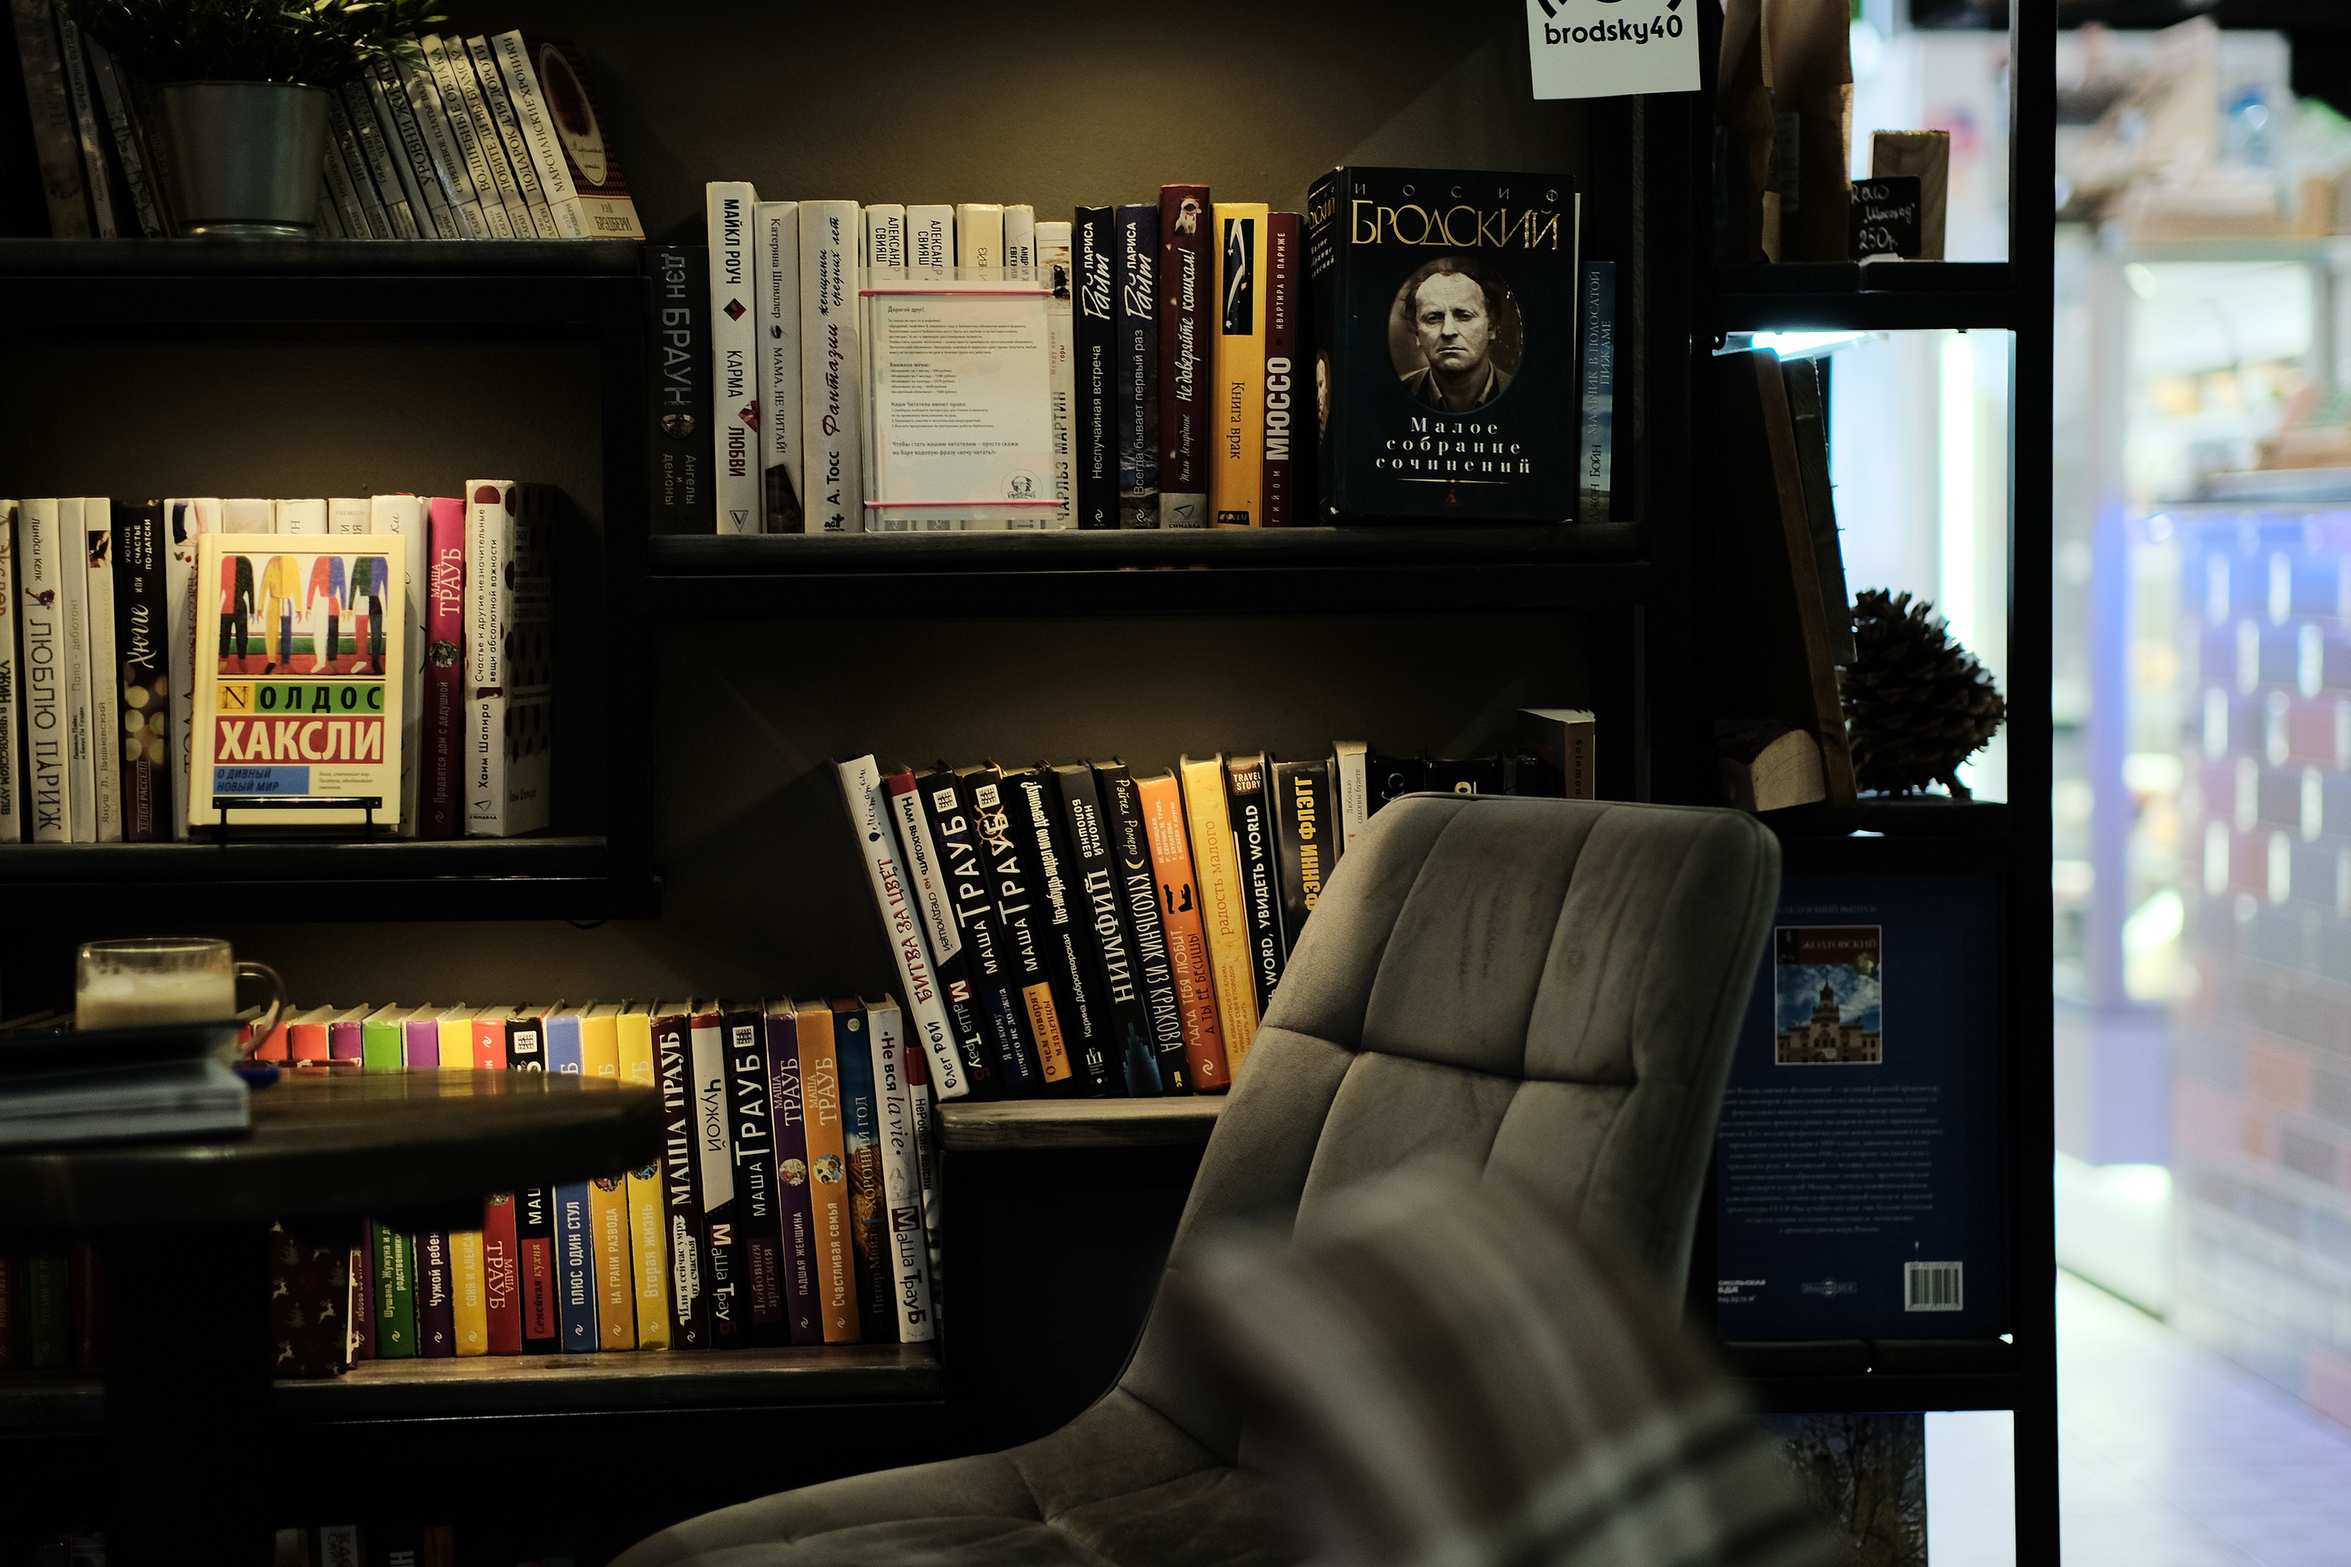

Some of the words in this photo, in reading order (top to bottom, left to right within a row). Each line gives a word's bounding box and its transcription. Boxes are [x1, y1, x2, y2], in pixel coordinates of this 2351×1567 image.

[1544, 14, 1683, 45] brodsky40
[472, 43, 502, 99] ДОРОТИ
[502, 36, 531, 97] ХРОНИКИ
[492, 100, 513, 129] ДЛЯ
[399, 119, 434, 186] УРОВНИ
[504, 129, 537, 192] ПОДАРОК
[524, 97, 565, 192] МАРСИАНСКИЕ
[1353, 183, 1559, 203] ИОСИФ
[723, 199, 739, 246] МАЙКЛ
[770, 218, 781, 268] Катерина
[829, 216, 840, 245] лет
[876, 227, 887, 262] СВИЯШ
[1083, 222, 1094, 269] ЛАРИСА
[1126, 222, 1137, 269] ЛАРИСА
[1351, 199, 1561, 251] БРОДСКИЙ
[726, 251, 741, 284] РОУЧ
[918, 231, 929, 265] СВИЯШ
[1277, 232, 1286, 269] ПАРИЖЕ
[771, 270, 784, 318] Шпиллер
[818, 249, 830, 316] женщины
[830, 254, 842, 307] средних
[1082, 252, 1111, 320] Райт
[1124, 252, 1153, 320] Райт
[1276, 284, 1285, 329] КВАРТИРА
[1134, 329, 1145, 351] раз
[1601, 320, 1612, 384] ПИЖАМЕ
[728, 350, 743, 398] КАРМА
[822, 323, 841, 436] Фантазии
[1091, 345, 1103, 394] встреча
[1133, 354, 1145, 401] первый
[1054, 392, 1069, 454] МАРТИН
[1133, 404, 1145, 448] бывает
[1230, 382, 1245, 423] Книга
[1266, 357, 1291, 460] МЮССО
[1410, 417, 1498, 435] Малое
[728, 427, 745, 477] ЛЮБВИ
[1091, 398, 1104, 479] Неслучайная
[1226, 426, 1240, 459] врак
[1386, 436, 1521, 456] собрание
[826, 451, 840, 485] Тосс
[1133, 452, 1145, 495] Всегда
[1375, 457, 1531, 474] сочинений
[827, 489, 840, 505] А.
[1055, 461, 1070, 521] ЧАРЛЬЗ
[1272, 470, 1281, 523] ГИЙОМ
[32, 518, 42, 556] Линдси
[133, 524, 141, 564] СЧАСТЬЕ
[144, 519, 152, 570] ПО-ДАТСКИ
[477, 509, 486, 592] незначительные
[33, 558, 43, 582] Келк
[431, 563, 441, 599] МАША
[440, 548, 462, 616] ТРАУБ
[490, 539, 498, 587] важности
[127, 604, 156, 669] Хюгге
[477, 595, 487, 630] другие
[487, 590, 498, 653] абсолютной
[29, 619, 56, 729] ЛЮБЛЮ
[475, 643, 485, 683] Счастье
[490, 656, 498, 683] вещи
[218, 721, 381, 760] ХАКСЛИ
[479, 703, 490, 753] Шапира
[35, 741, 62, 830] ПАРИЖ
[216, 781, 254, 793] НОВЫЙ
[256, 782, 279, 792] МИР
[217, 769, 224, 779] О
[227, 767, 271, 779] ДИВНЫЙ
[477, 757, 489, 789] Хаим
[1237, 780, 1261, 791] STORY
[1070, 797, 1093, 859] БОЛОШНЕВ
[1083, 803, 1104, 857] НИКОЛАЙ
[1294, 773, 1318, 840] ФЛЭГГ
[1202, 819, 1222, 874] малого
[1244, 803, 1264, 862] WORLD
[876, 855, 906, 905] ЦВЕТ
[939, 812, 993, 927] ТРАУБ
[979, 808, 1034, 924] ТРАУБ
[1298, 842, 1321, 911] ФЭННИ
[1125, 871, 1165, 962] КУКОЛЬНИК
[1211, 877, 1235, 936] радость
[1251, 862, 1272, 928] УВИДЕТЬ
[891, 907, 912, 933] ЗА
[1014, 916, 1039, 972] МАША
[1082, 866, 1136, 1005] ЦИФМИН
[899, 935, 934, 1004] БИТВА
[973, 919, 999, 974] МАША
[1058, 931, 1085, 1003] Добротворская
[1170, 925, 1189, 974] ЛЮБИТ,
[1260, 932, 1278, 985] WORD,
[1143, 963, 1169, 984] ИЗ
[1179, 978, 1194, 1004] ТЕБЯ
[1027, 988, 1049, 1037] говорят
[1041, 998, 1065, 1057] младенцы
[1075, 1003, 1093, 1039] Карина
[1148, 986, 1183, 1053] КРАКОВА
[1185, 1008, 1203, 1047] МАМА
[659, 1032, 685, 1113] ТРАУБ
[881, 1037, 896, 1060] Не
[1039, 1037, 1053, 1063] чем
[1045, 1064, 1057, 1076] О
[772, 1076, 783, 1109] МАША
[781, 1057, 802, 1127] ТРАУБ
[807, 1075, 818, 1109] МАША
[815, 1057, 838, 1126] ТРАУБ
[886, 1064, 898, 1091] вся
[703, 1078, 726, 1152] Чужой
[734, 1054, 770, 1166] ТРАУБ
[854, 1095, 872, 1127] ГОД
[886, 1096, 903, 1110] la
[888, 1115, 909, 1149] vie
[666, 1118, 693, 1206] МАША
[852, 1129, 877, 1210] ХОРОШИЙ
[750, 1162, 767, 1217] МАША
[567, 1201, 580, 1230] СТУЛ
[607, 1208, 620, 1253] РАЗВОДА
[641, 1203, 656, 1247] жизнь
[792, 1212, 807, 1257] ЖЕНЩИНА
[826, 1202, 841, 1237] семья
[892, 1208, 923, 1267] Маша
[530, 1243, 544, 1278] кухня
[568, 1233, 583, 1267] ОДИН
[608, 1255, 621, 1287] ГРАНИ
[829, 1241, 846, 1306] Счастливая
[488, 1240, 506, 1309] ТРАУБ
[503, 1258, 514, 1293] МАША
[570, 1270, 585, 1305] ПЛЮС
[609, 1290, 623, 1304] НА
[642, 1251, 660, 1298] Вторая
[796, 1259, 810, 1296] ПАДШАЯ
[903, 1270, 927, 1325] Трауб
[531, 1280, 546, 1335] Семейная
